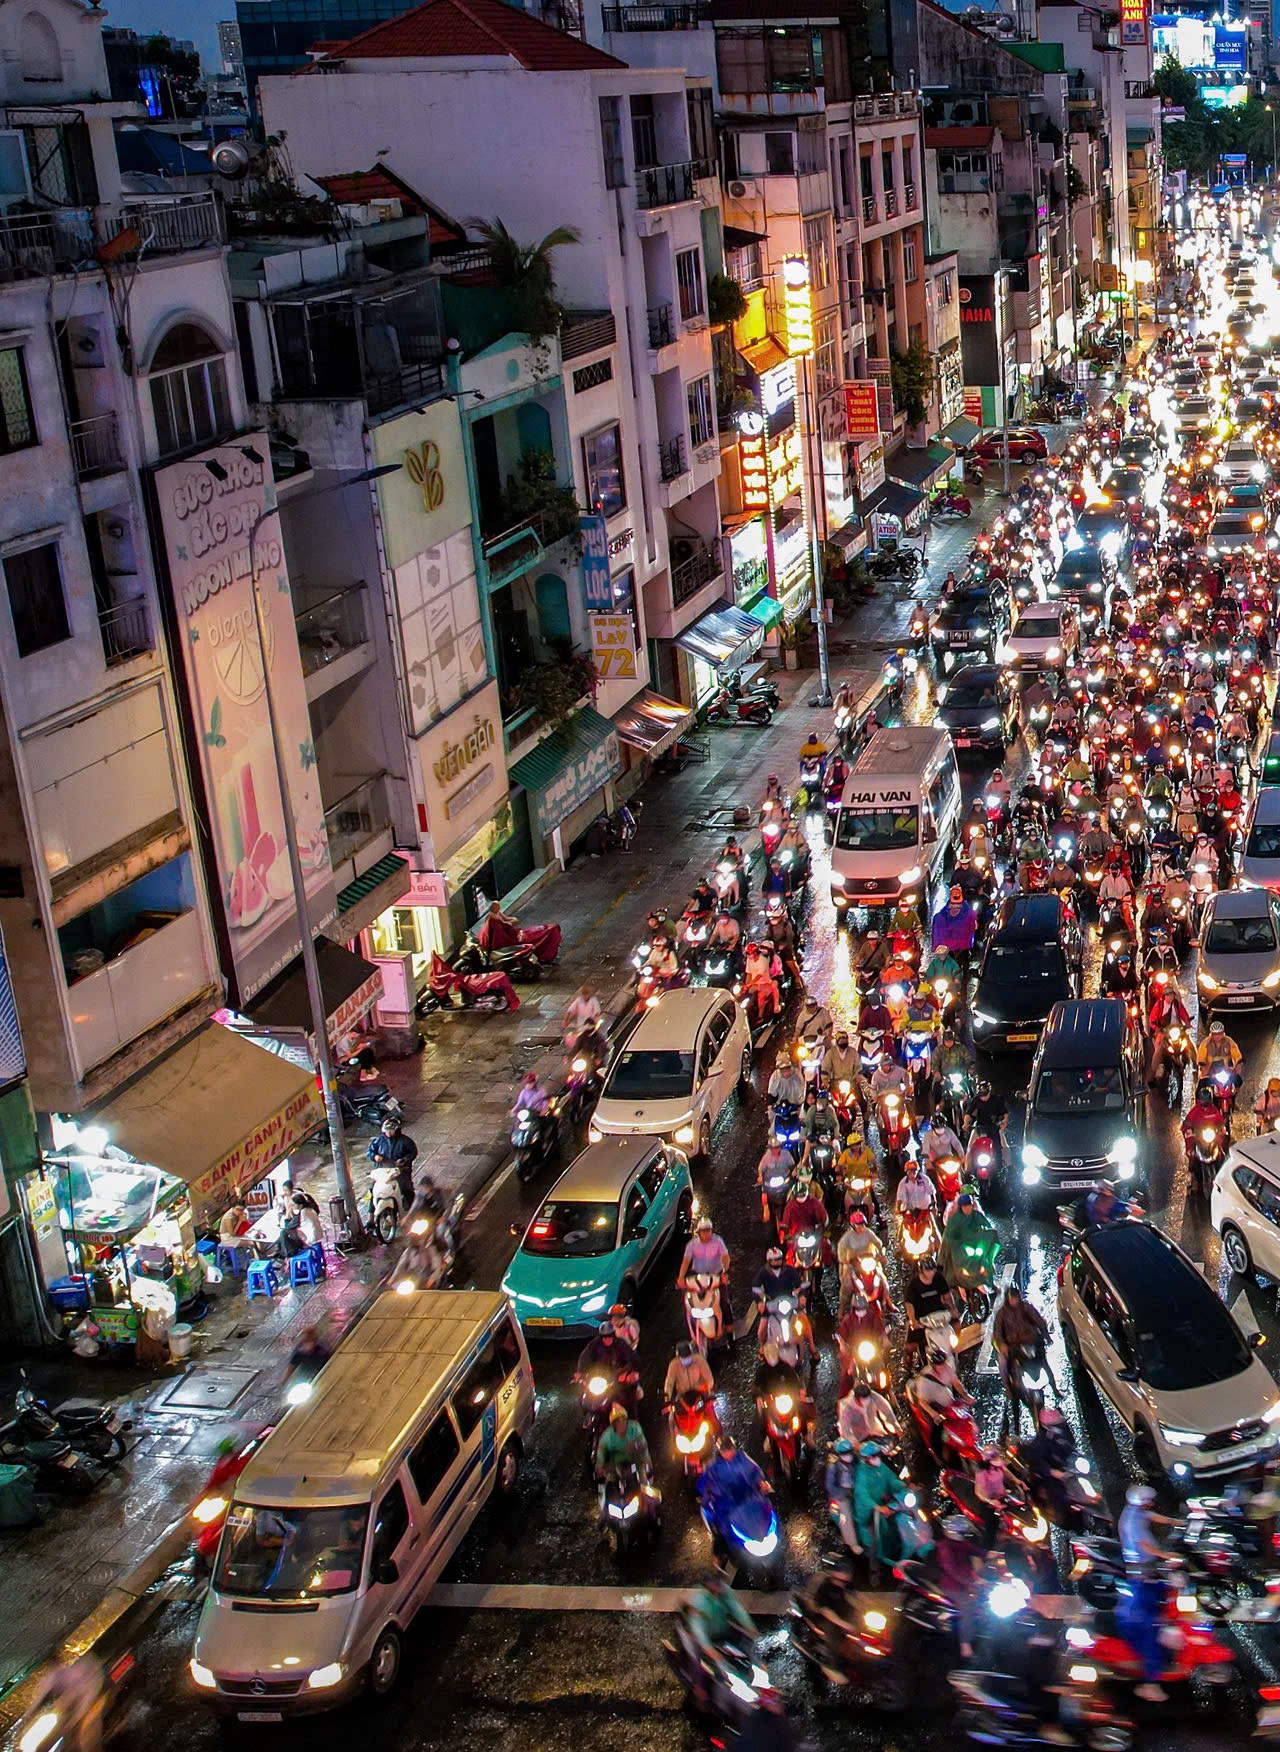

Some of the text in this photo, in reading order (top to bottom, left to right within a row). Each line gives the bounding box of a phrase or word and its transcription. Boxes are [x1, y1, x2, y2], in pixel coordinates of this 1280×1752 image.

[1124, 10, 1143, 20] ANH
[230, 538, 282, 583] MING
[596, 631, 627, 645] L&V
[596, 648, 635, 676] 72
[851, 791, 911, 803] HAI VAN
[244, 1116, 281, 1156] CANH
[285, 1092, 311, 1121] CUA
